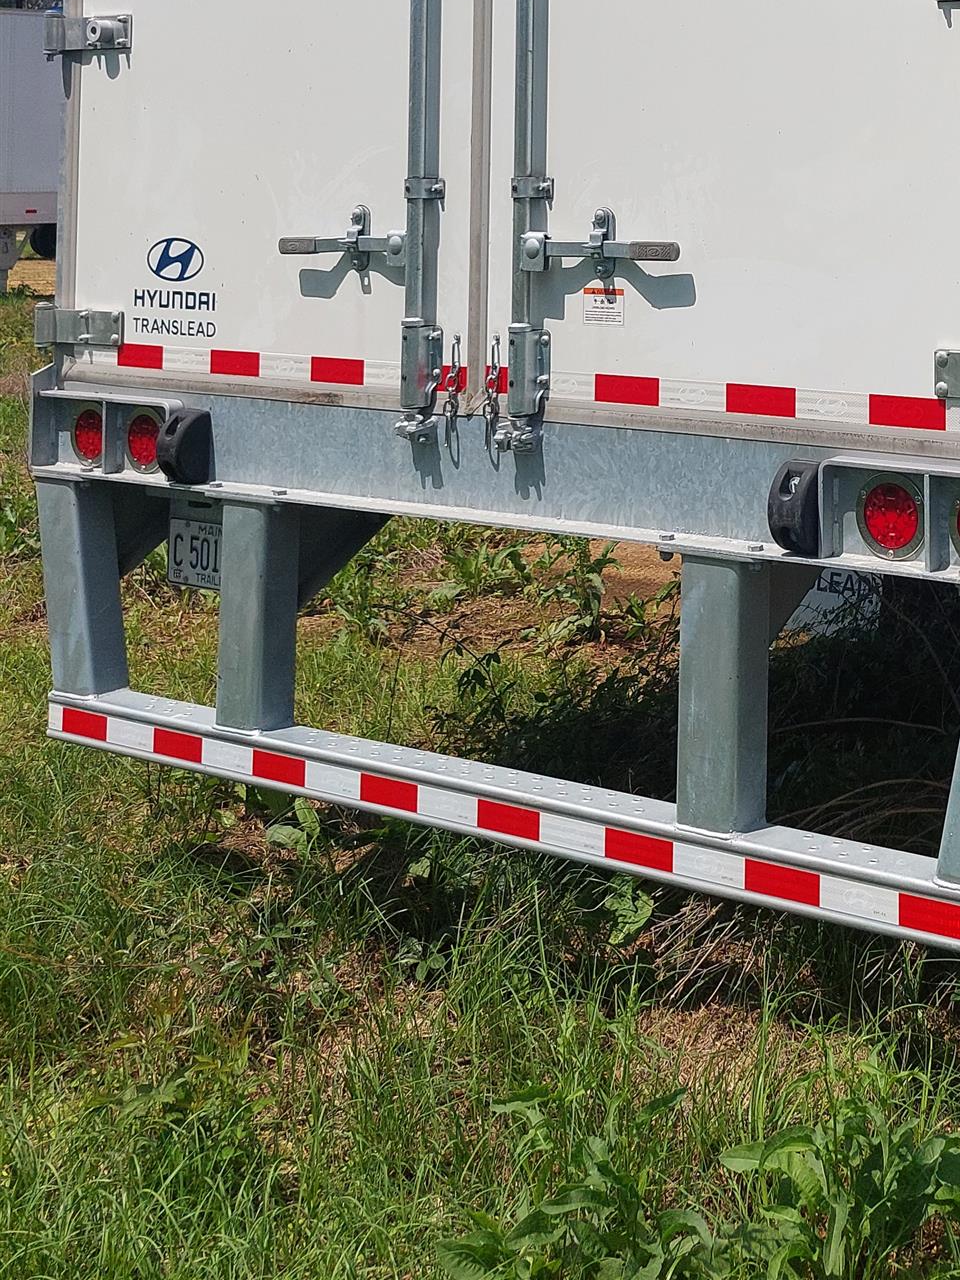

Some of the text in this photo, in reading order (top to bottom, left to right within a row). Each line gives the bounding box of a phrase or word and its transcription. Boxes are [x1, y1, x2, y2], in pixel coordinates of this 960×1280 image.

[133, 288, 216, 311] HYUNDAI
[132, 317, 217, 338] TRANSLEAD
[196, 572, 221, 587] TRAIL
